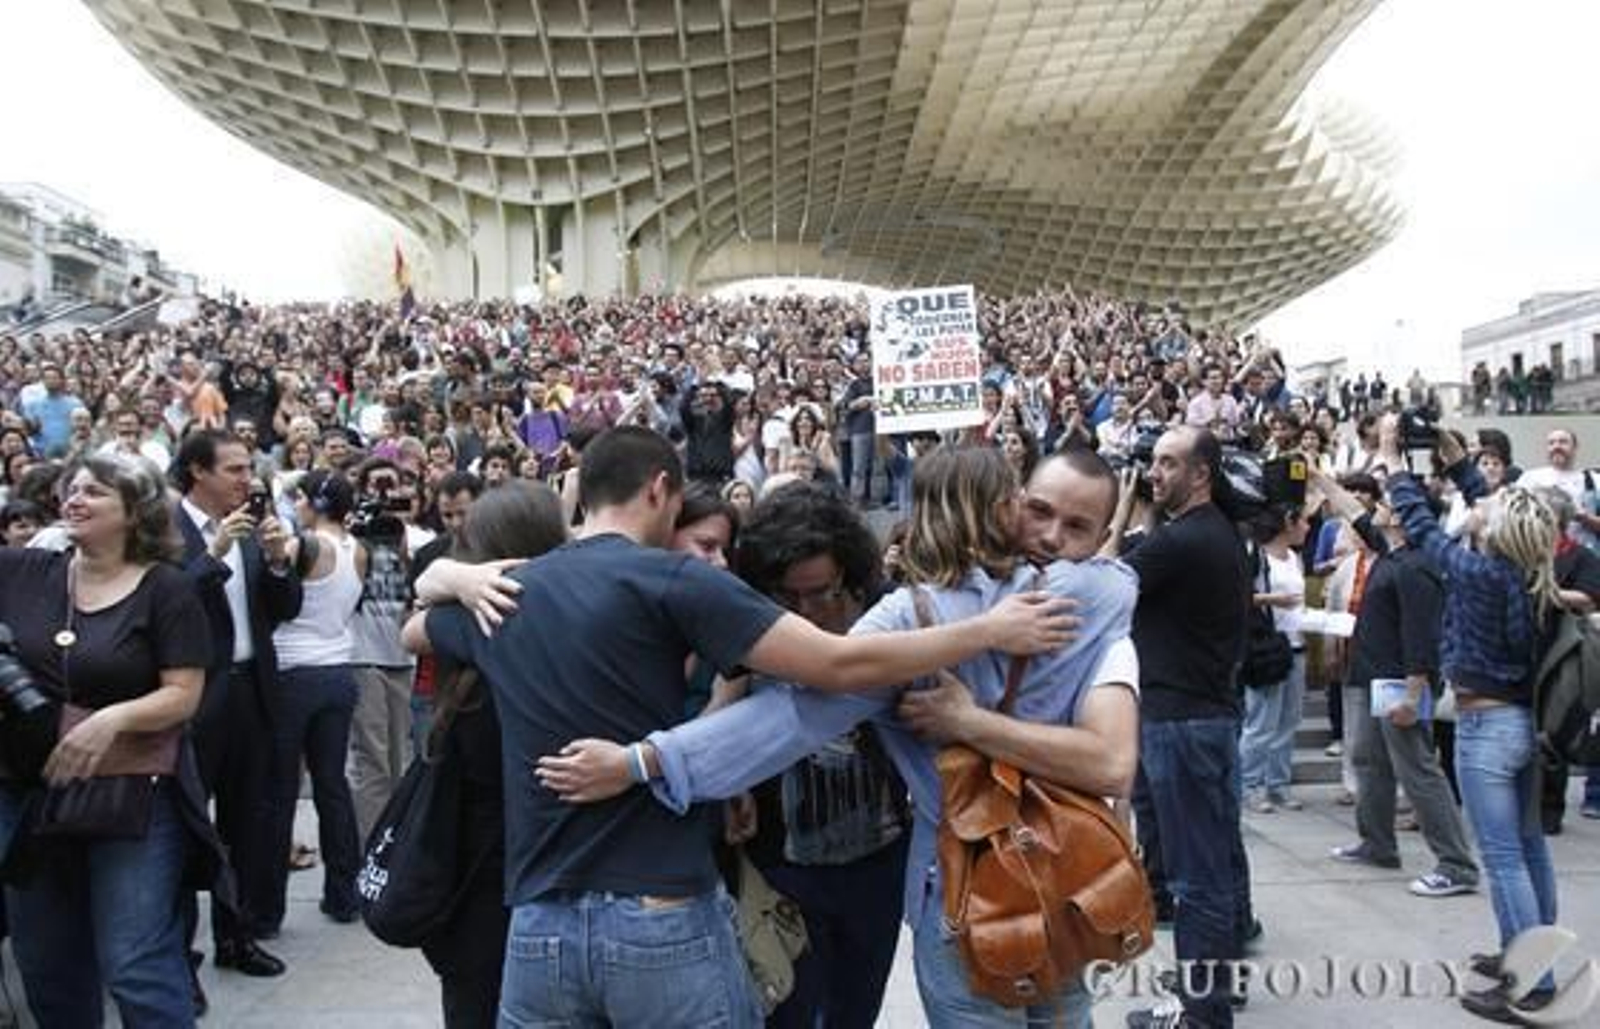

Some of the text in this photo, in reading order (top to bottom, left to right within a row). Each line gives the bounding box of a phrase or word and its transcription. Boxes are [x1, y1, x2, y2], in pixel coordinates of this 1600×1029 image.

[896, 292, 971, 316] QUE
[878, 360, 977, 385] NO SABEN
